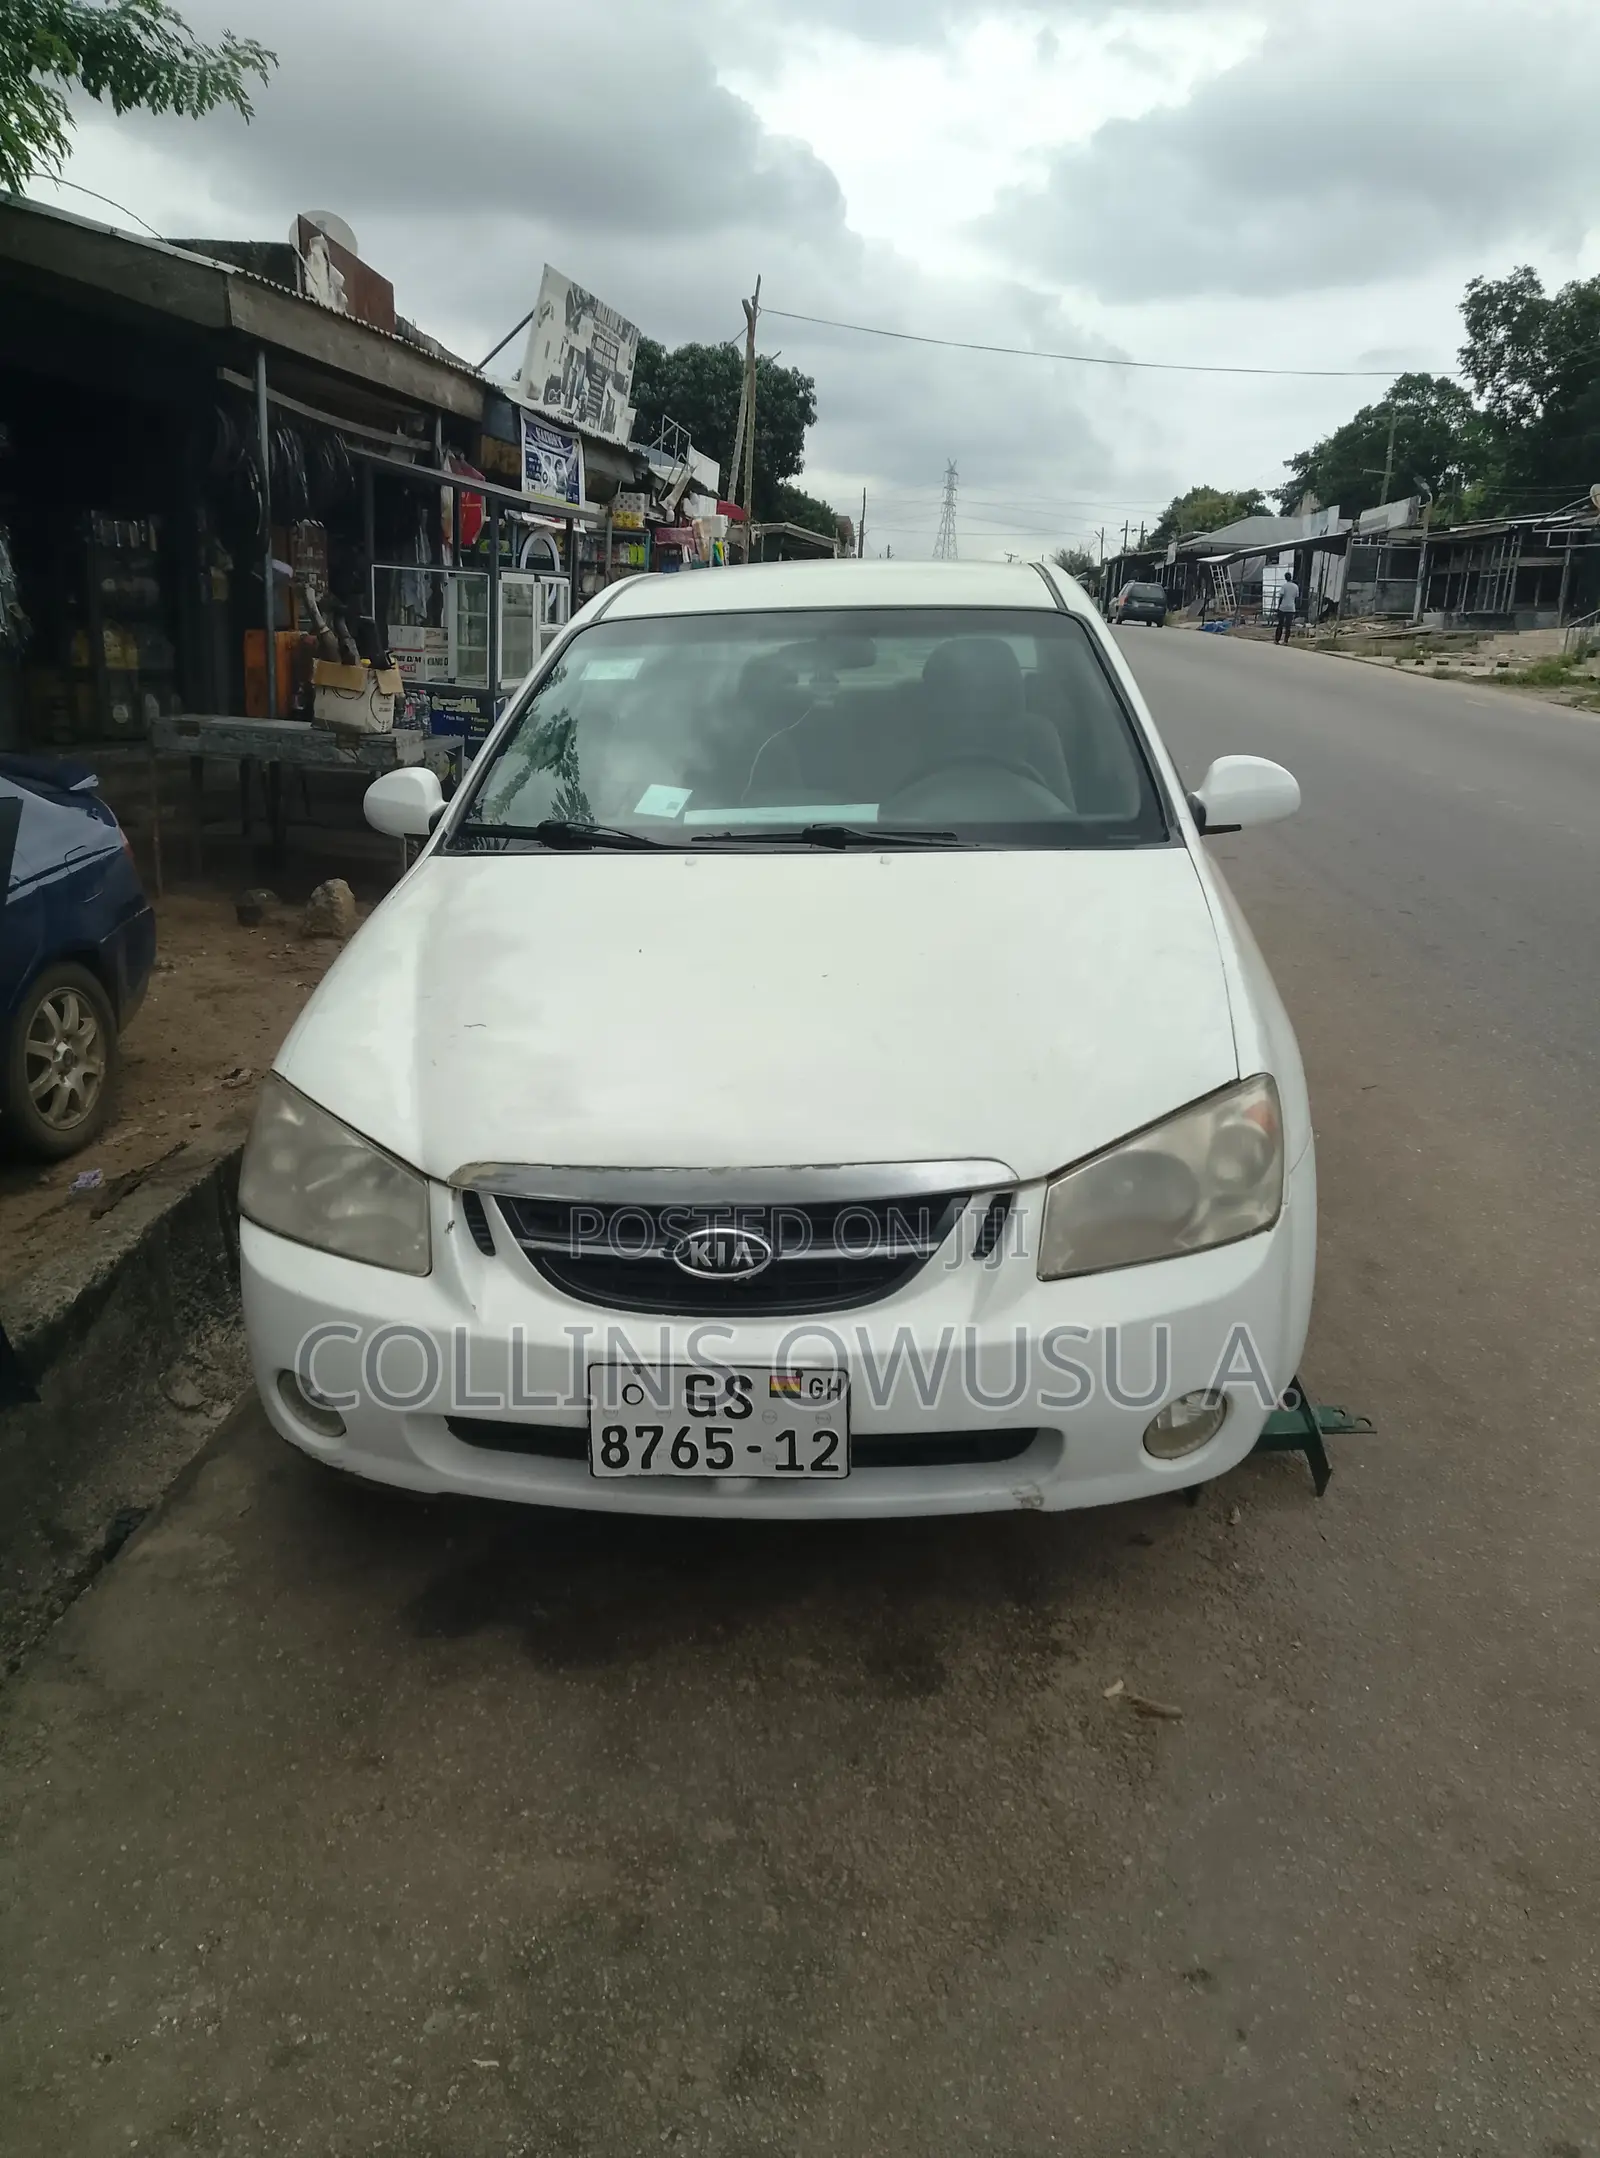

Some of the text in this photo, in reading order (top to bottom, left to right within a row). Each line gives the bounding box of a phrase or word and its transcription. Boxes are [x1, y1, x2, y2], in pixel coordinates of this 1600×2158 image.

[689, 1240, 755, 1267] KIA
[685, 1373, 843, 1420] GS GH
